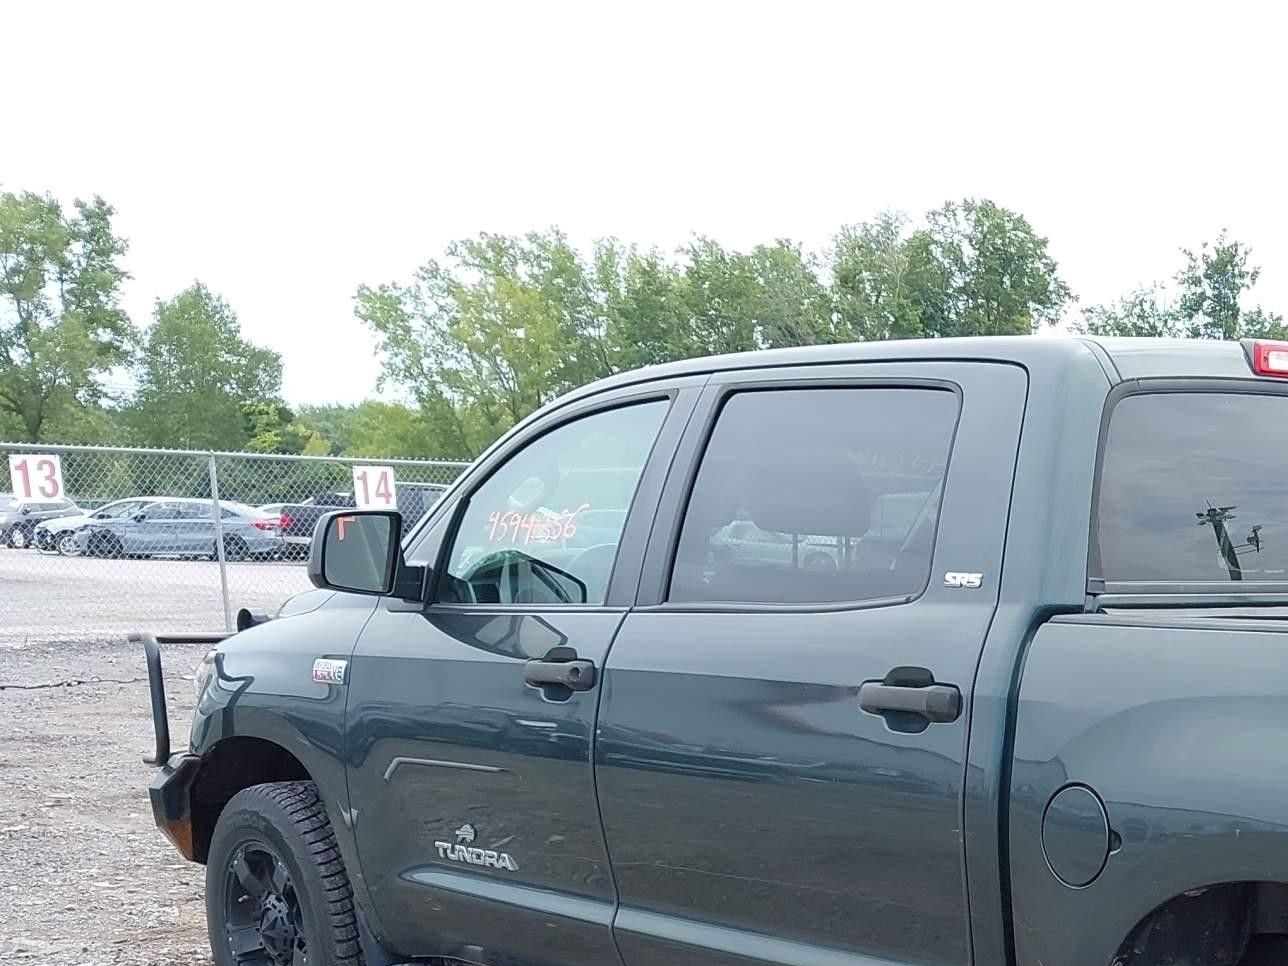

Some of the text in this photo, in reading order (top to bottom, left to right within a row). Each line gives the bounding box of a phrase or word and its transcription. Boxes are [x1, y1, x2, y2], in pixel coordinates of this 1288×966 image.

[13, 458, 60, 499] 13
[355, 471, 393, 505] 14
[943, 571, 984, 589] SR5
[433, 840, 520, 871] TUNDRA
